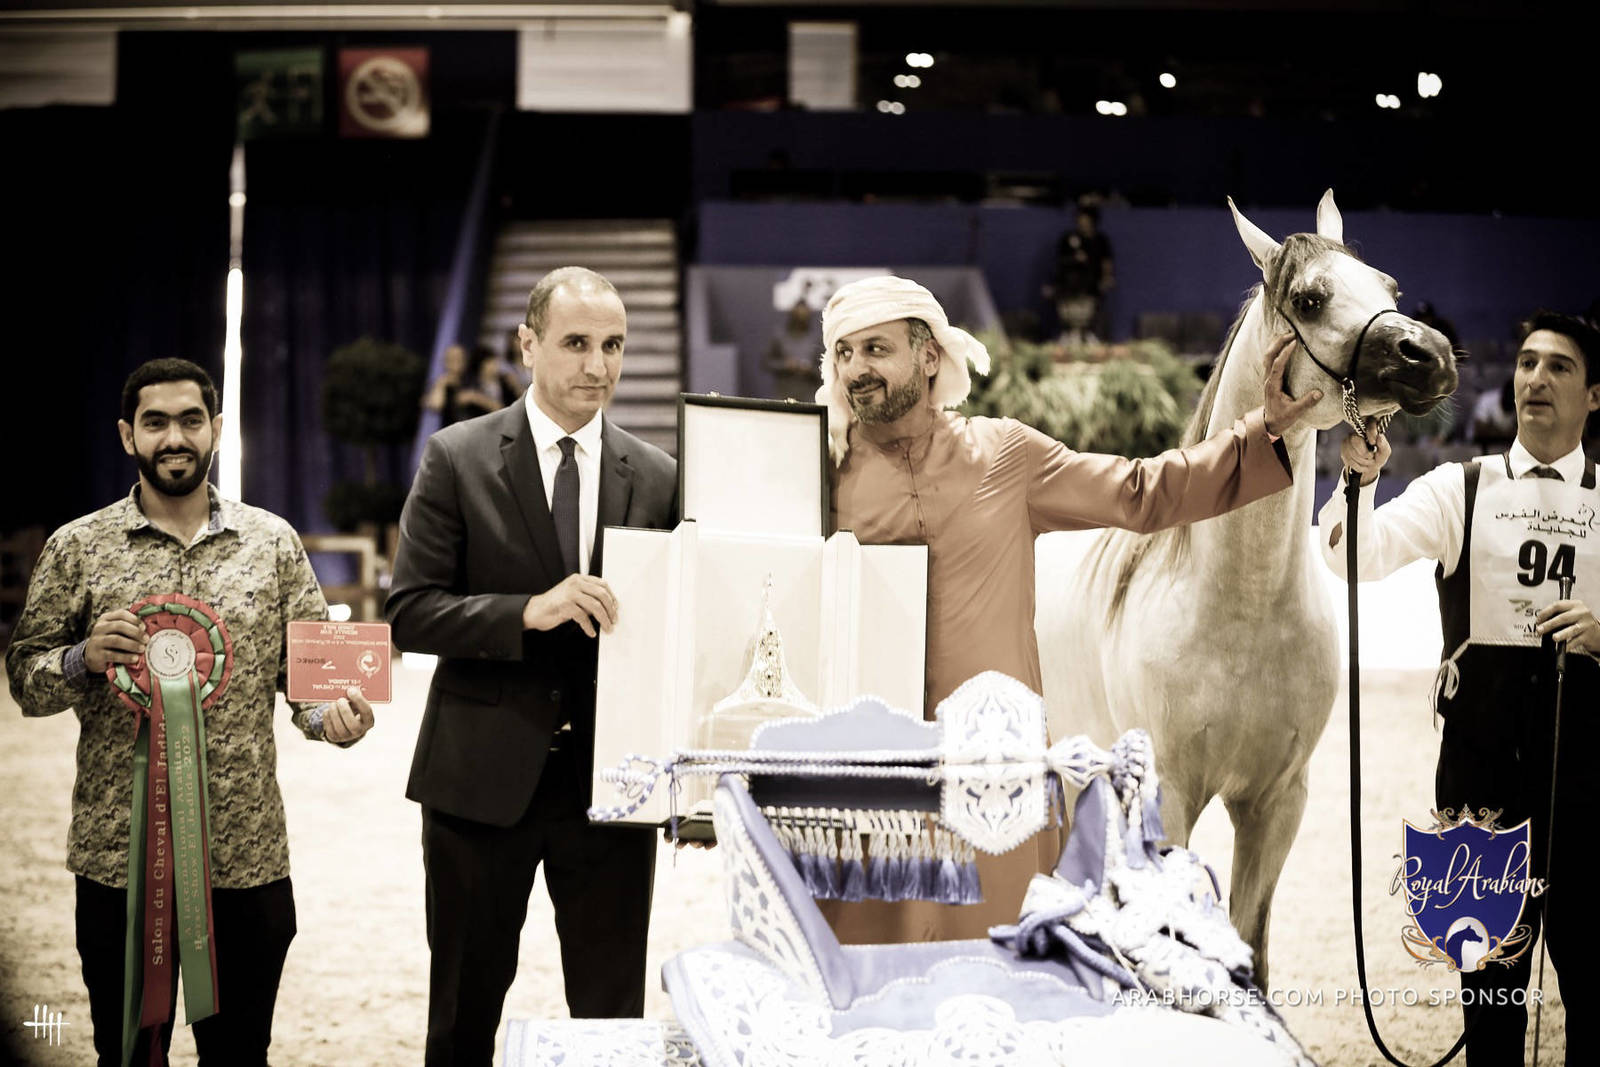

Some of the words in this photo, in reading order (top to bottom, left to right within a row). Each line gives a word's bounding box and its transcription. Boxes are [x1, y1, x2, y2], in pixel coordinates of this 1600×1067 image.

[1517, 538, 1576, 587] 94
[181, 725, 193, 767] 2022
[173, 740, 184, 802] Arabian
[154, 778, 167, 813] d'El
[184, 771, 195, 827] Jadida
[153, 820, 167, 880] Cheval
[187, 833, 197, 849] El
[153, 888, 164, 909] du
[190, 857, 200, 897] Show
[151, 917, 164, 966] Salon
[194, 905, 203, 951] Horse
